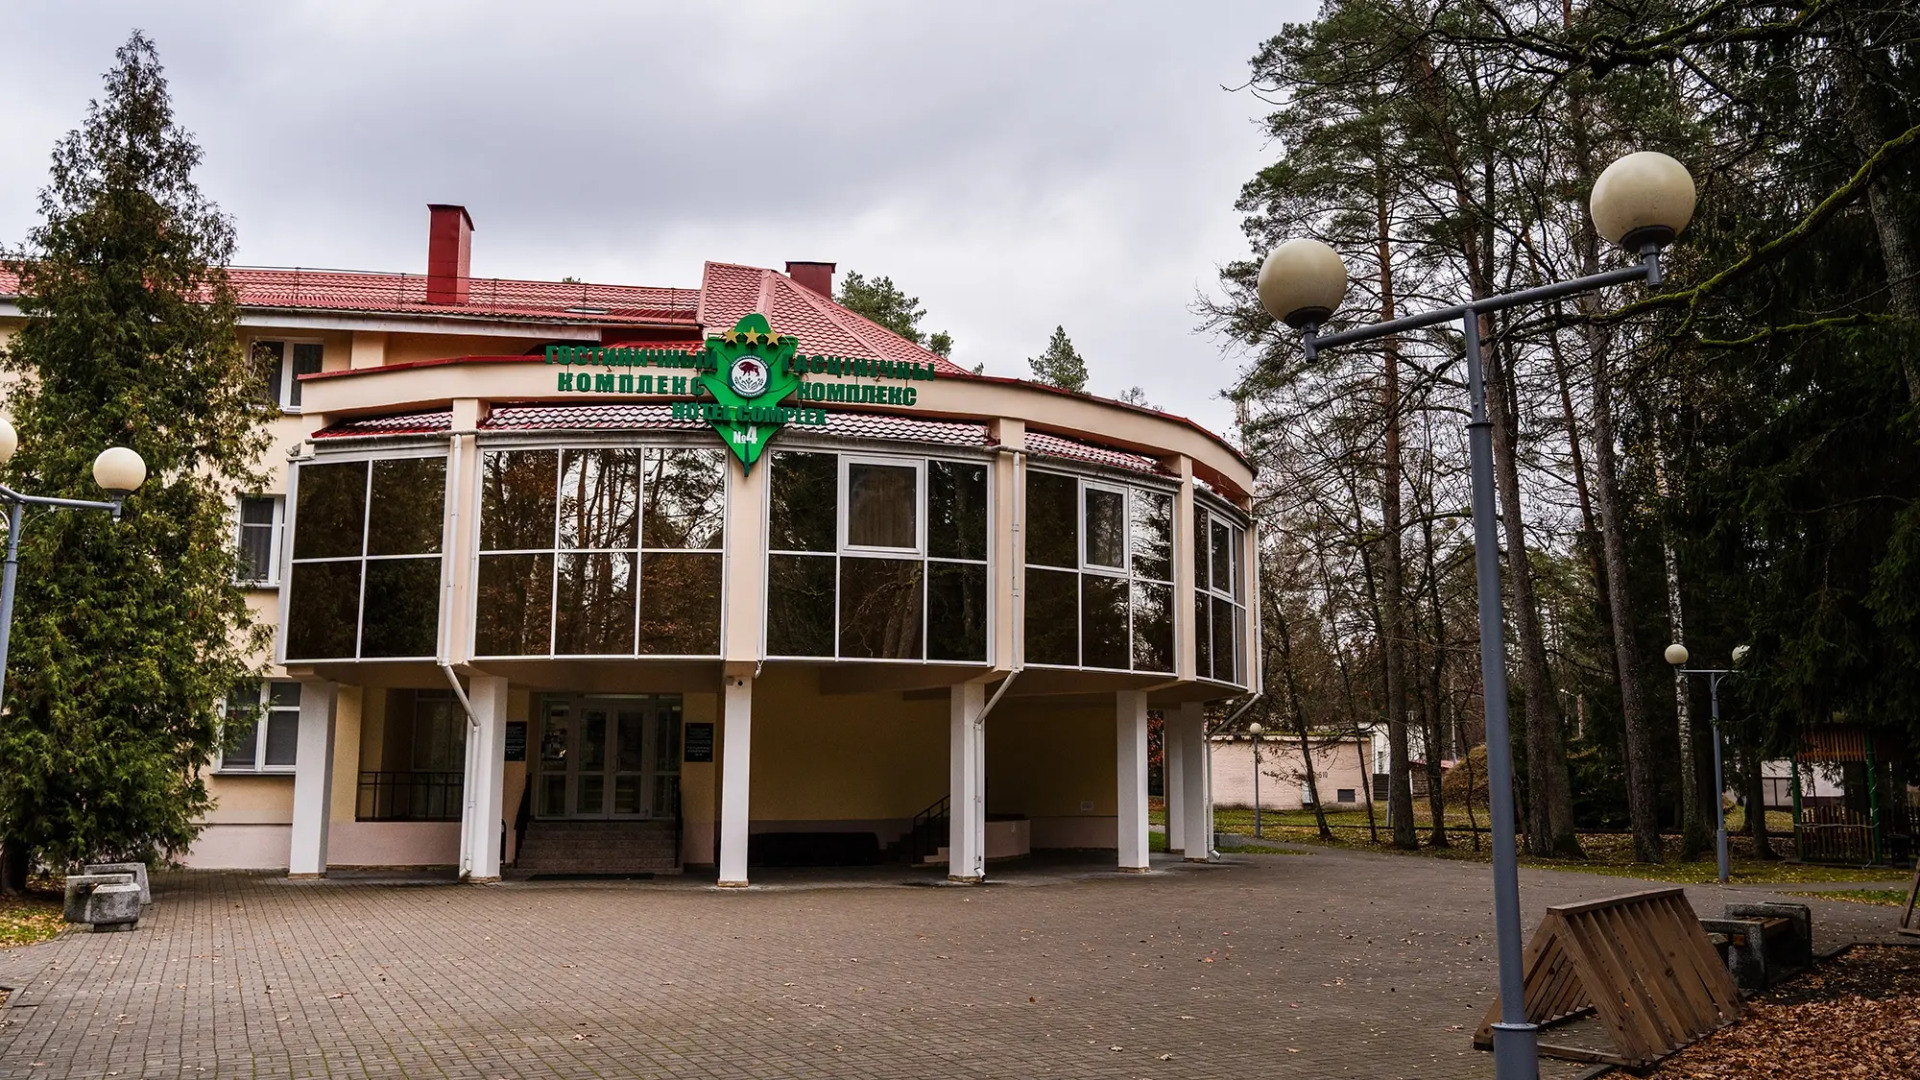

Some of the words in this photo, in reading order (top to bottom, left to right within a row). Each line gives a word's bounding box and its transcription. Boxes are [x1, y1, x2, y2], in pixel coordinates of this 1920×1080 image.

[557, 372, 705, 396] КОМПЛЕКС
[797, 381, 917, 406] КОМПЛЕКС
[672, 402, 731, 422] HOTEL
[736, 405, 827, 425] COMPLEX
